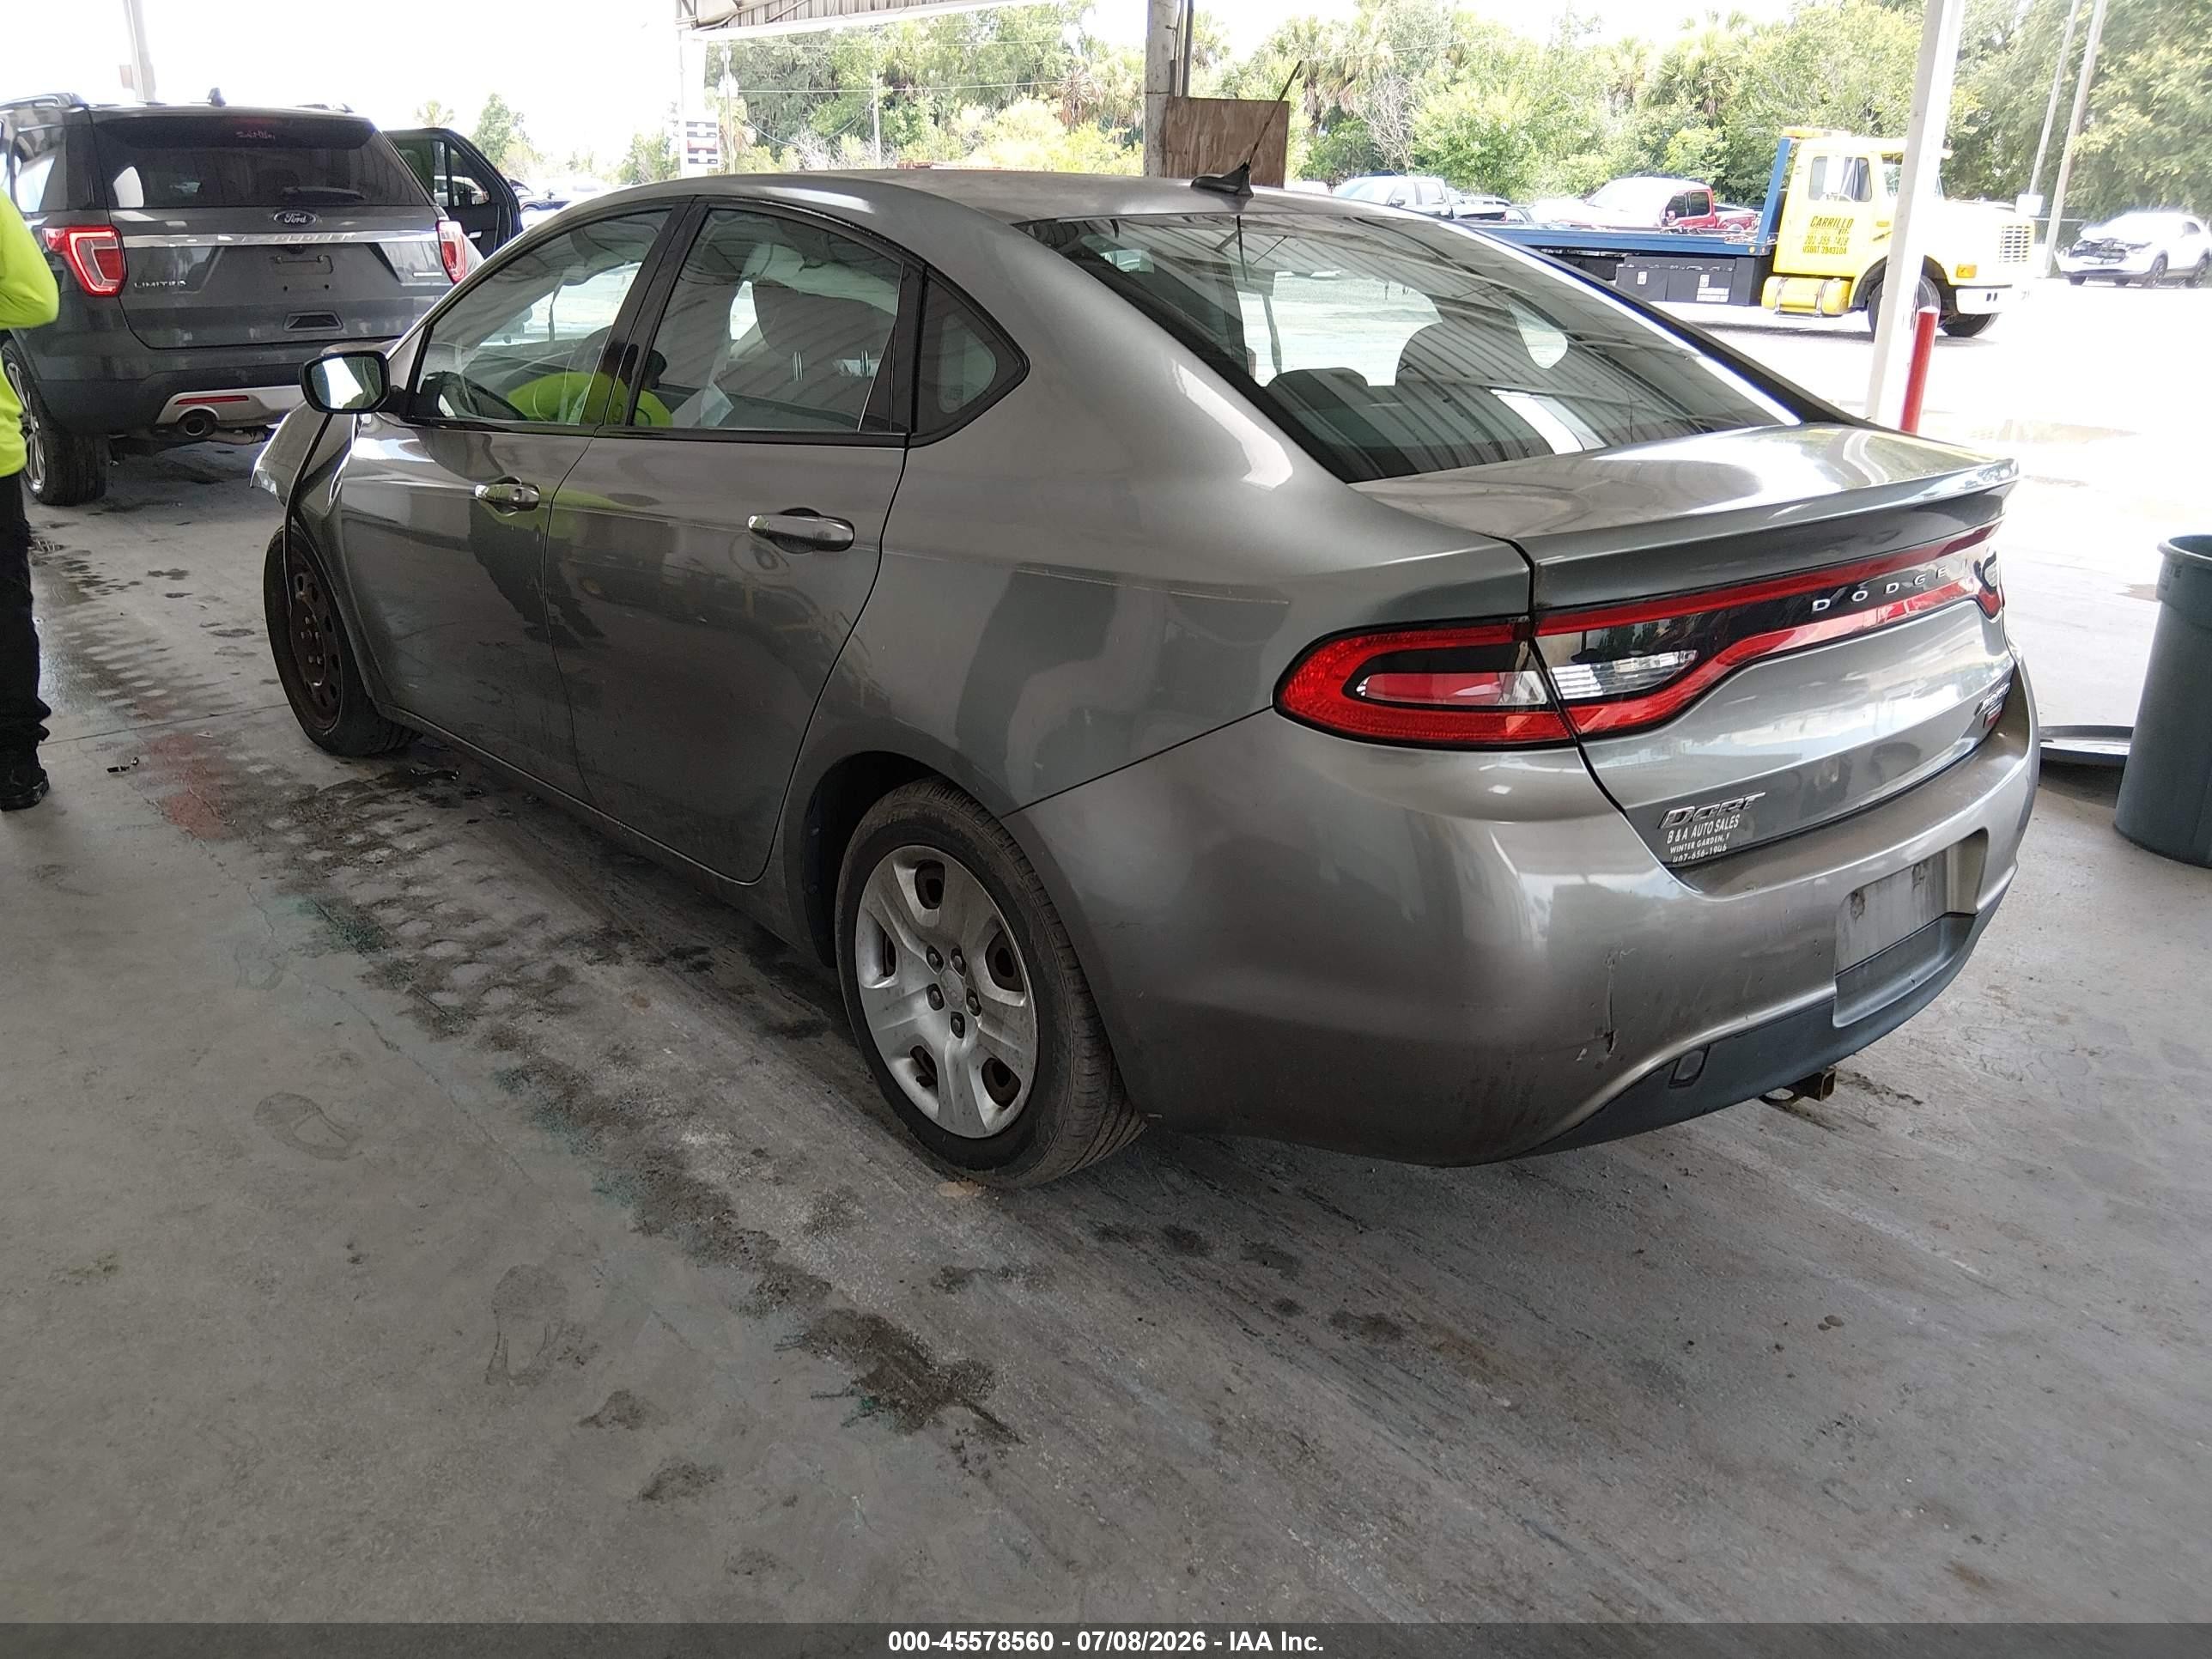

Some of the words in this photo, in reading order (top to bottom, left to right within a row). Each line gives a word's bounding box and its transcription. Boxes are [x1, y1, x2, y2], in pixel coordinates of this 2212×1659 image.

[284, 213, 307, 223] Ford
[1810, 216, 1854, 228] CARRILLO
[1812, 566, 1947, 613] DODGE
[1667, 830, 1674, 844] B
[1675, 829, 1681, 842] &
[1681, 827, 1688, 841] A
[1691, 821, 1714, 839] AUTO
[1714, 814, 1741, 833] SALES
[1670, 842, 1695, 854] WINTER
